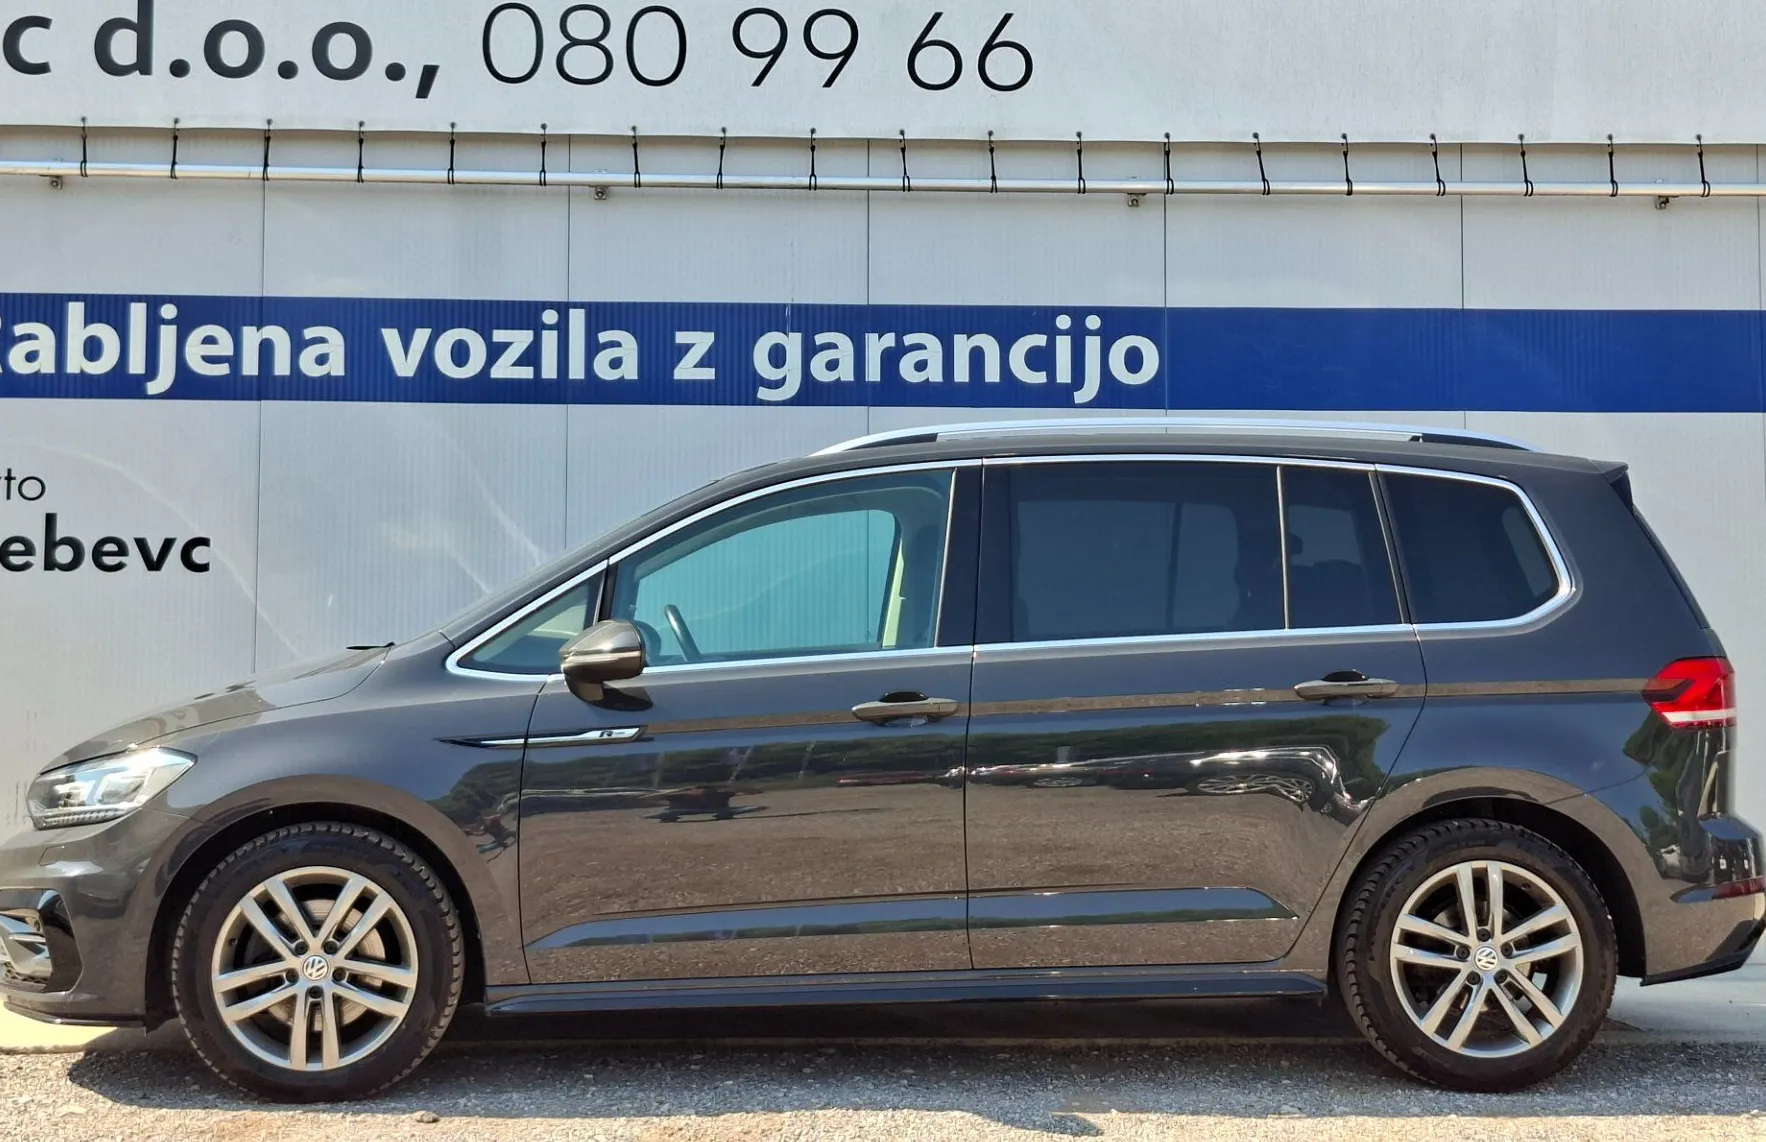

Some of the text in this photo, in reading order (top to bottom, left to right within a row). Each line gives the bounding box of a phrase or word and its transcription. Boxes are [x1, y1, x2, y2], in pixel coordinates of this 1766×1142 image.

[2, 0, 1034, 99] c d.o.o., 080 99 66
[0, 302, 1160, 403] abljena vozila z garancijo
[0, 467, 46, 501] to
[0, 512, 211, 573] ebevc
